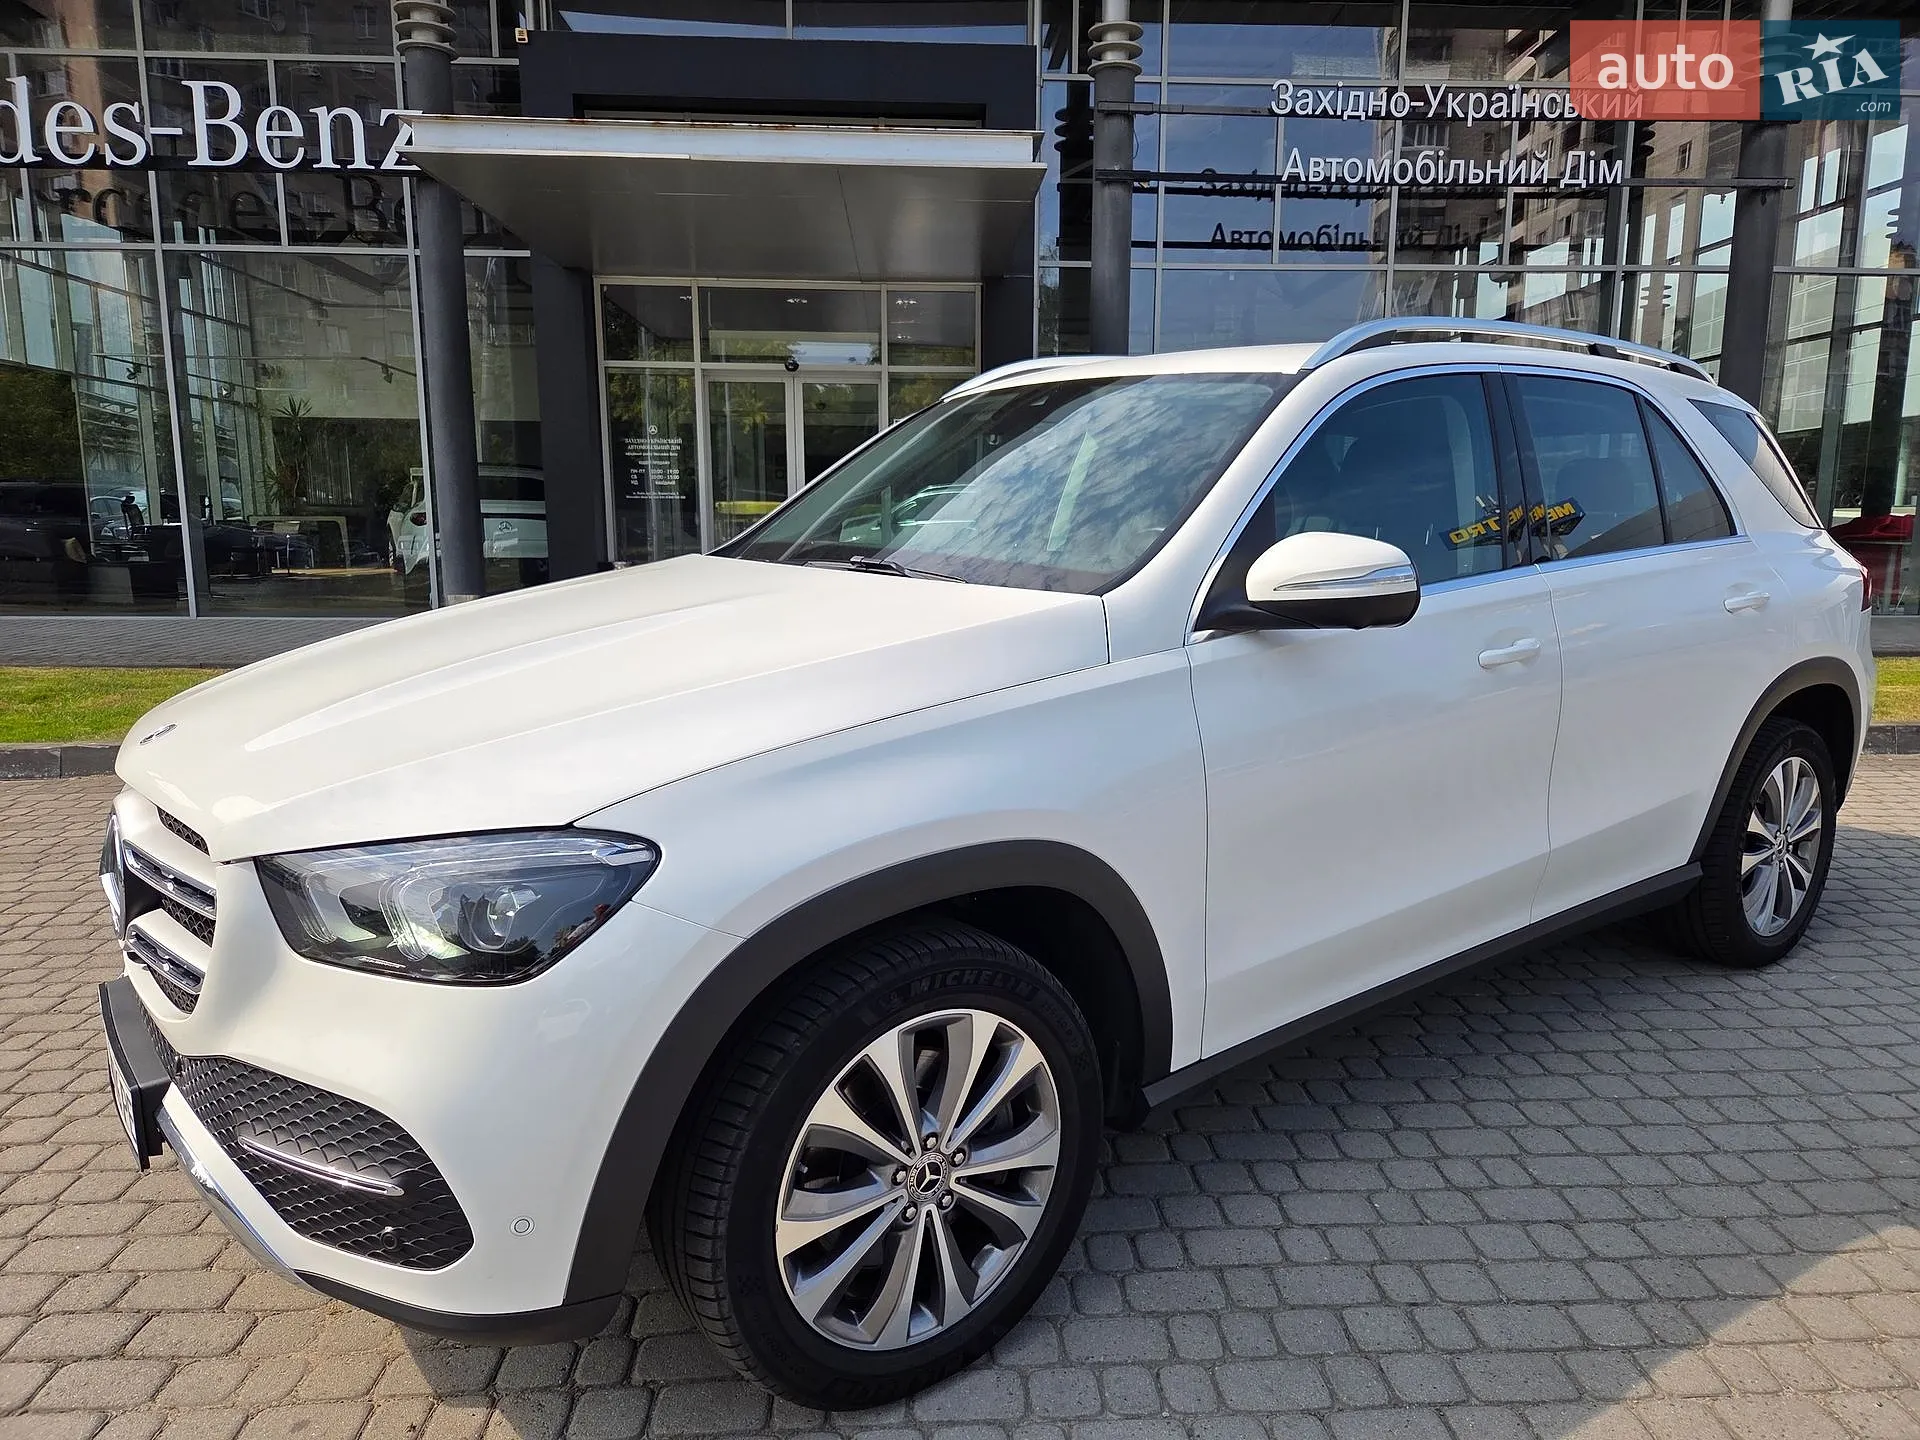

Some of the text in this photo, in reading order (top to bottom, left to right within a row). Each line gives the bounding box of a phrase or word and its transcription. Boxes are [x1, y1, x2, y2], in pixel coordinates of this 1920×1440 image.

[1282, 147, 1623, 188] Автомобільний Дім
[910, 970, 1036, 1001] MICHELIN
